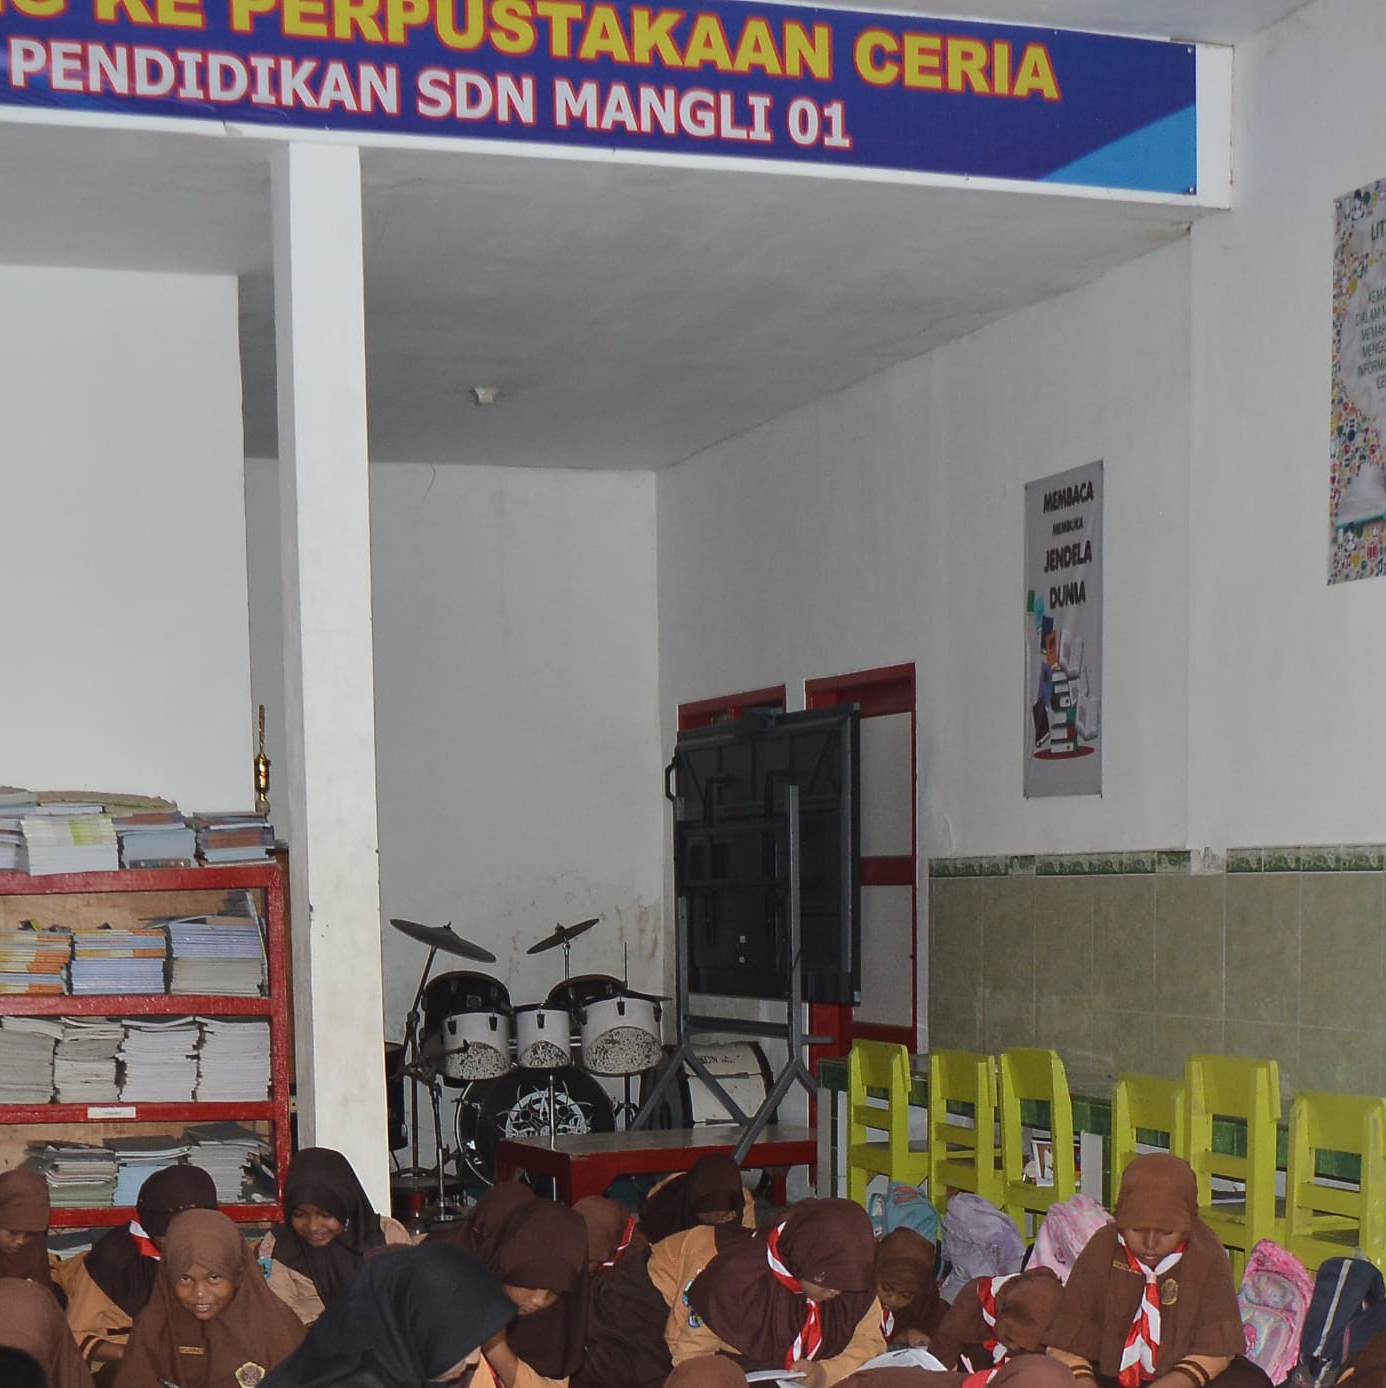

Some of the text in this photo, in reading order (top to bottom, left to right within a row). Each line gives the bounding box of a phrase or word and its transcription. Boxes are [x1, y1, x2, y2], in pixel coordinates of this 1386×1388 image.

[231, 0, 833, 81] PERPUSTAKAAN
[853, 30, 1062, 100] CERIA
[9, 37, 400, 114] PENDIDIKAN
[416, 70, 536, 124] SDN
[553, 81, 774, 142] MANGLI
[788, 98, 852, 148] 01
[1044, 540, 1092, 573] JENDELA
[1049, 580, 1086, 609] DUNIA
